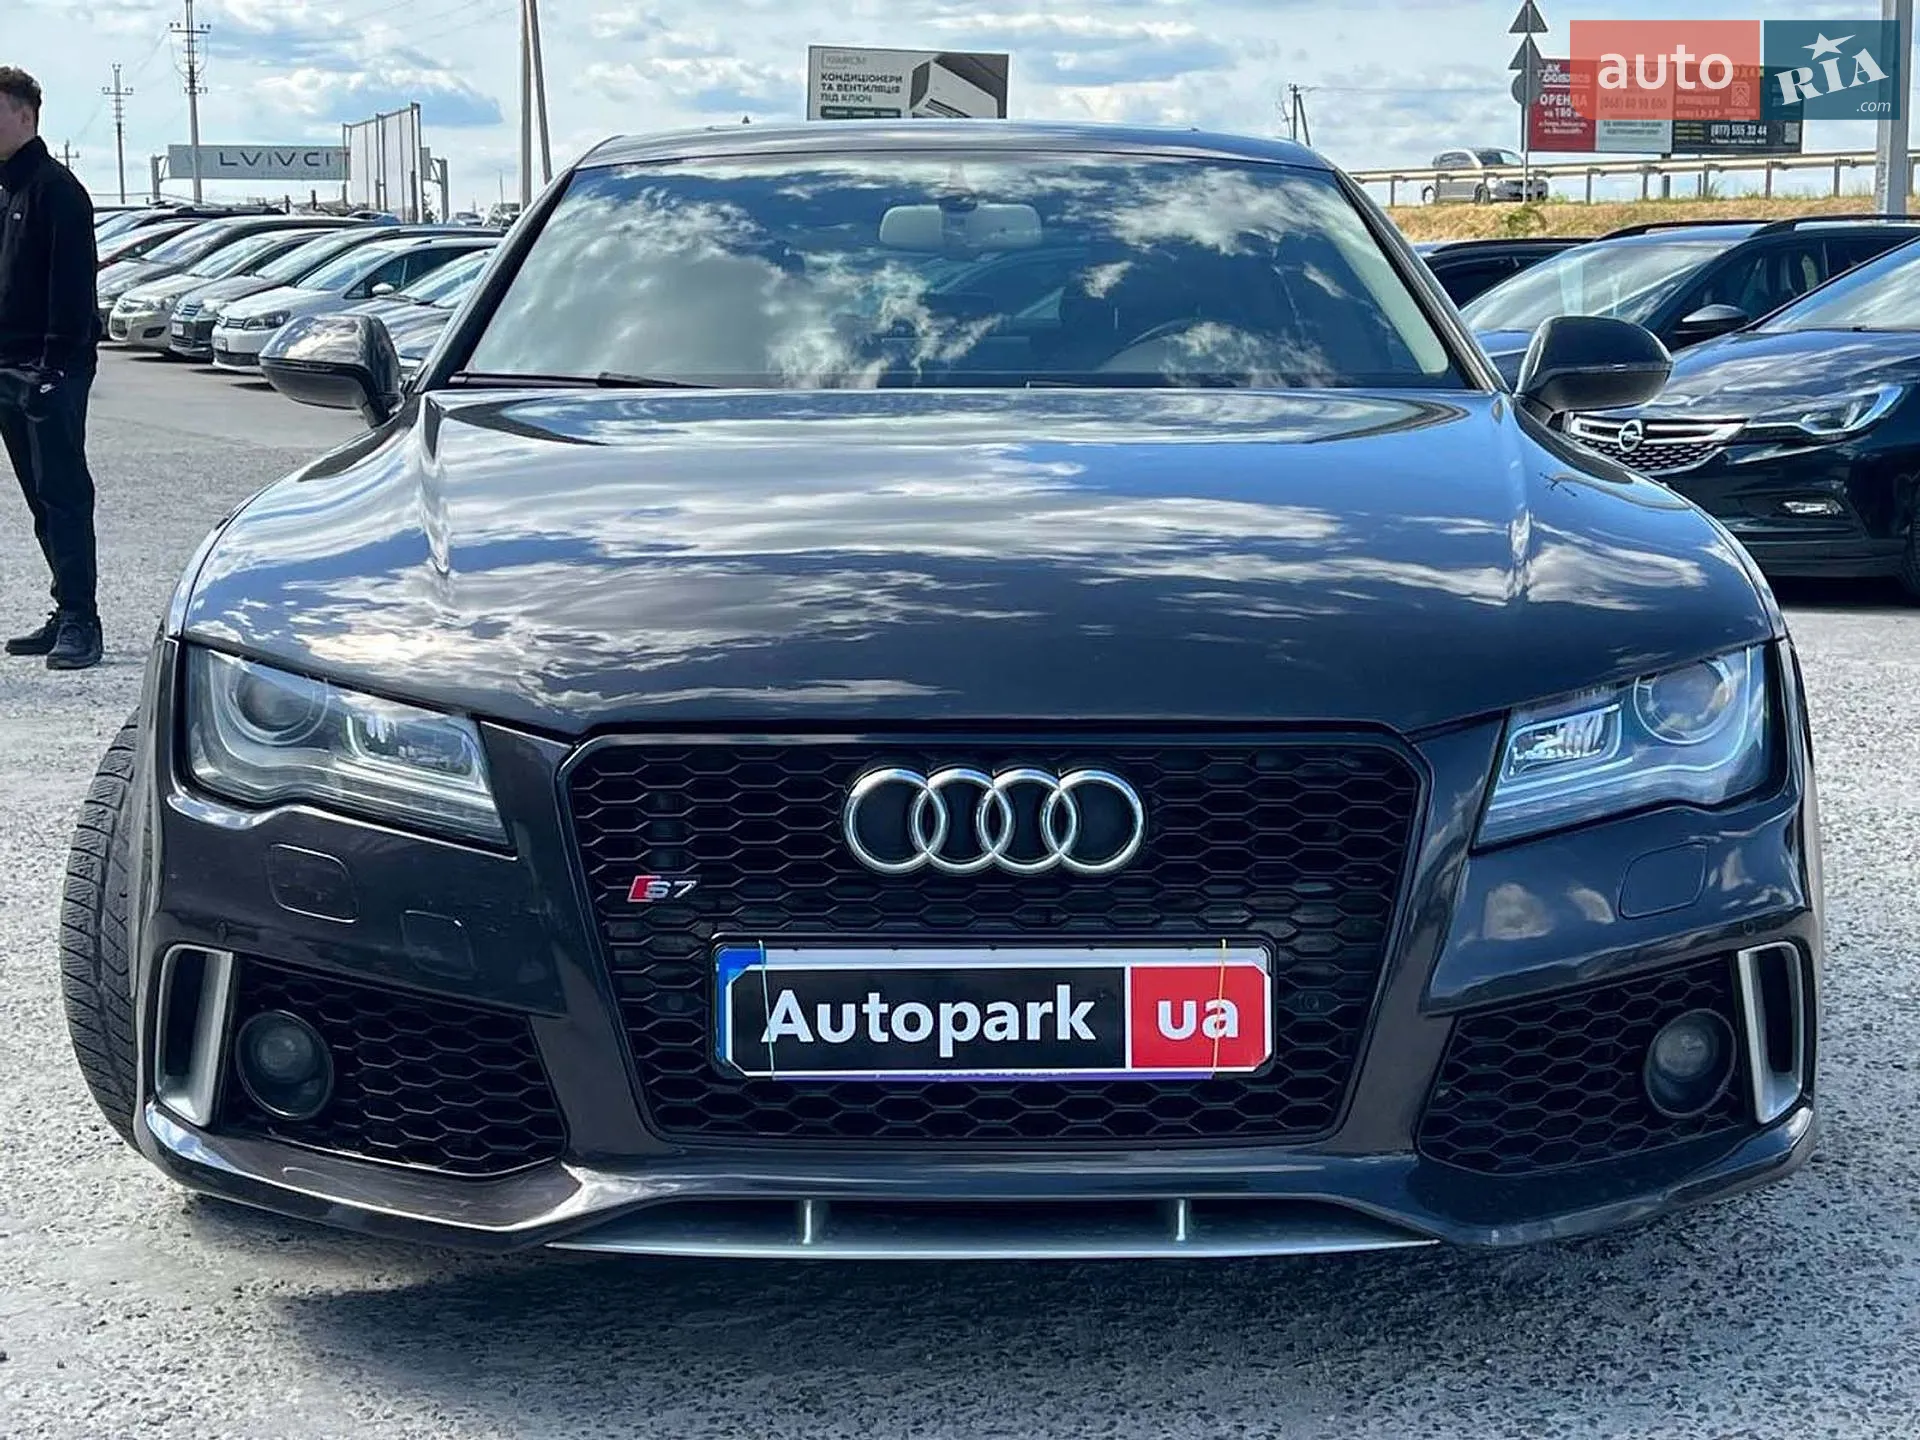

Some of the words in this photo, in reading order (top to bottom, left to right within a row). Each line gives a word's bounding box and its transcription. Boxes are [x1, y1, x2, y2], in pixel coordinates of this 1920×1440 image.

[820, 72, 903, 83] КОНДИЦІОНЕРИ
[820, 82, 834, 91] ТА
[836, 83, 900, 93] ВЕНТИЛЯЦІЯ
[820, 92, 839, 103] ПІД
[841, 93, 872, 103] КЛЮЧ
[1540, 94, 1588, 107] ОРЕНДА
[643, 880, 697, 899] S7
[760, 985, 1096, 1058] Autopark
[1156, 1000, 1239, 1039] ua
